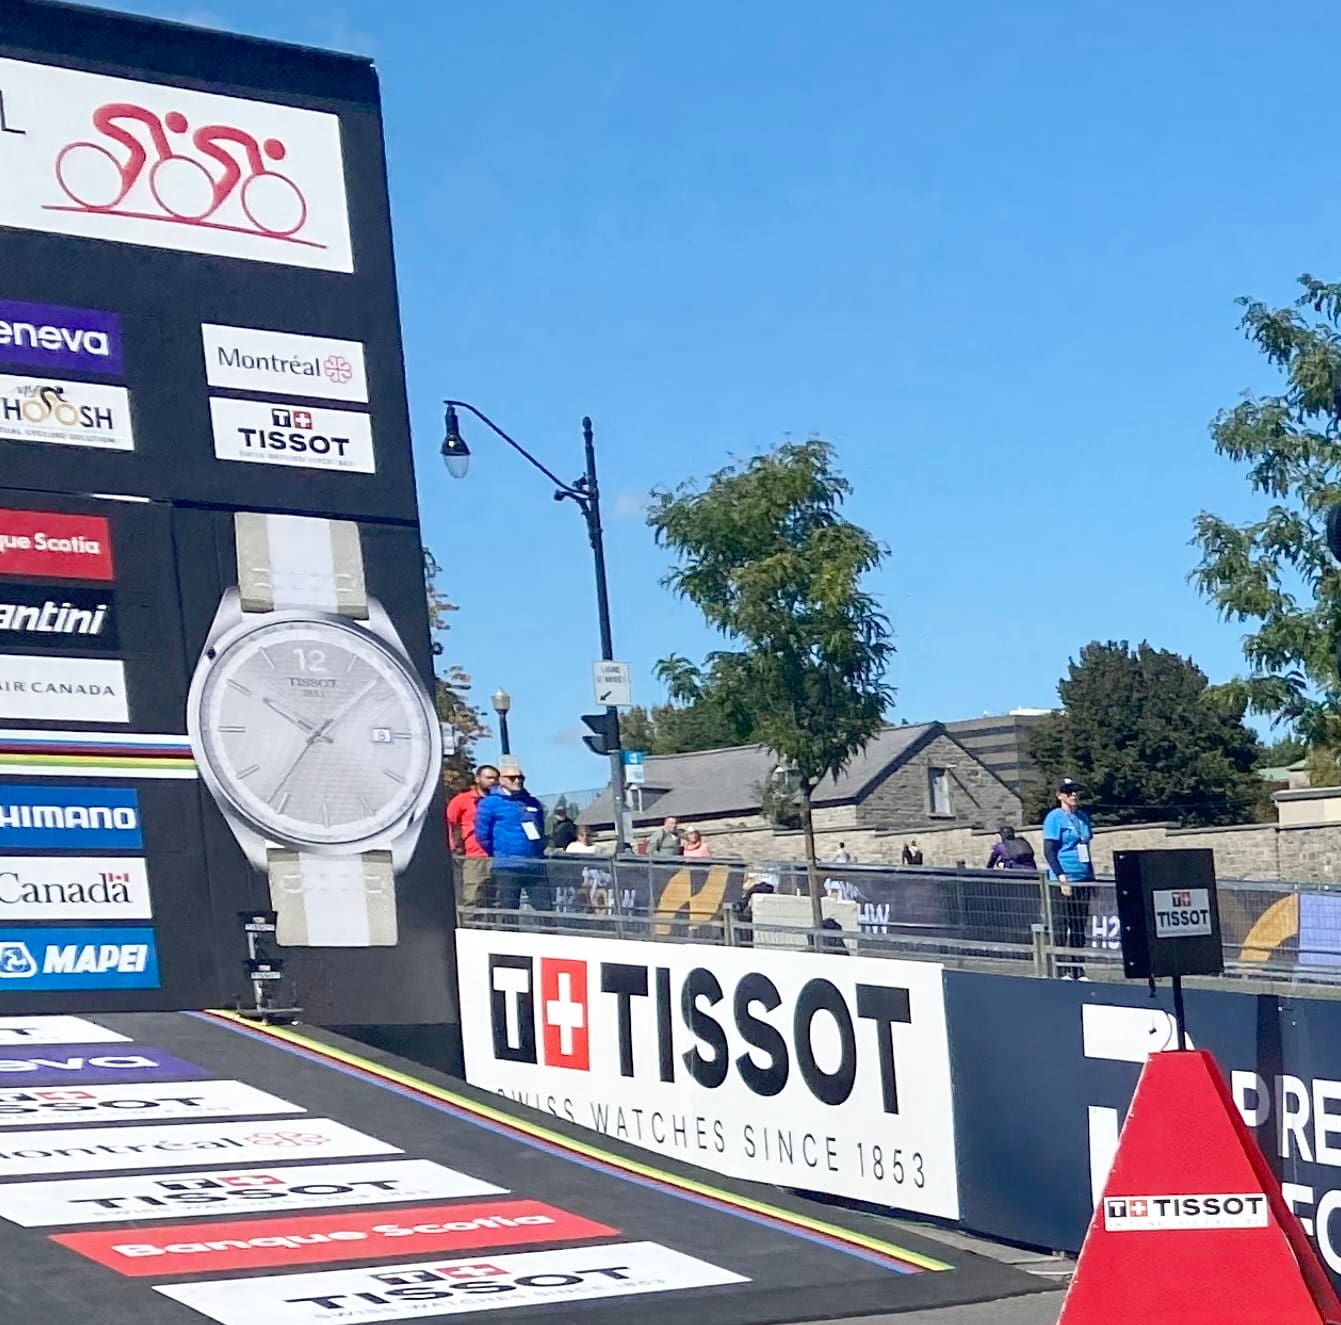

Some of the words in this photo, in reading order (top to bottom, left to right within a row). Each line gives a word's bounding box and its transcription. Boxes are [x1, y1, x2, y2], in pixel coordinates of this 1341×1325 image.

[218, 346, 321, 376] Montréal
[238, 427, 350, 457] TISSOT
[34, 532, 100, 555] Scotia
[0, 681, 25, 692] IR
[31, 681, 115, 697] CANADA
[0, 872, 130, 904] Canada
[1157, 909, 1209, 927] TISSOT
[43, 944, 148, 974] MAPEI
[600, 962, 912, 1115] TISSOT
[0, 1137, 244, 1159] ontréal
[590, 1103, 725, 1153] WATCHES
[744, 1125, 840, 1173] SINCE
[856, 1142, 926, 1191] 1853
[69, 1180, 399, 1209] TISSOT
[1153, 1197, 1263, 1217] TISSOT
[112, 1231, 368, 1257] Banque
[372, 1215, 556, 1238] Scotia
[285, 1267, 631, 1309] TISSOT
